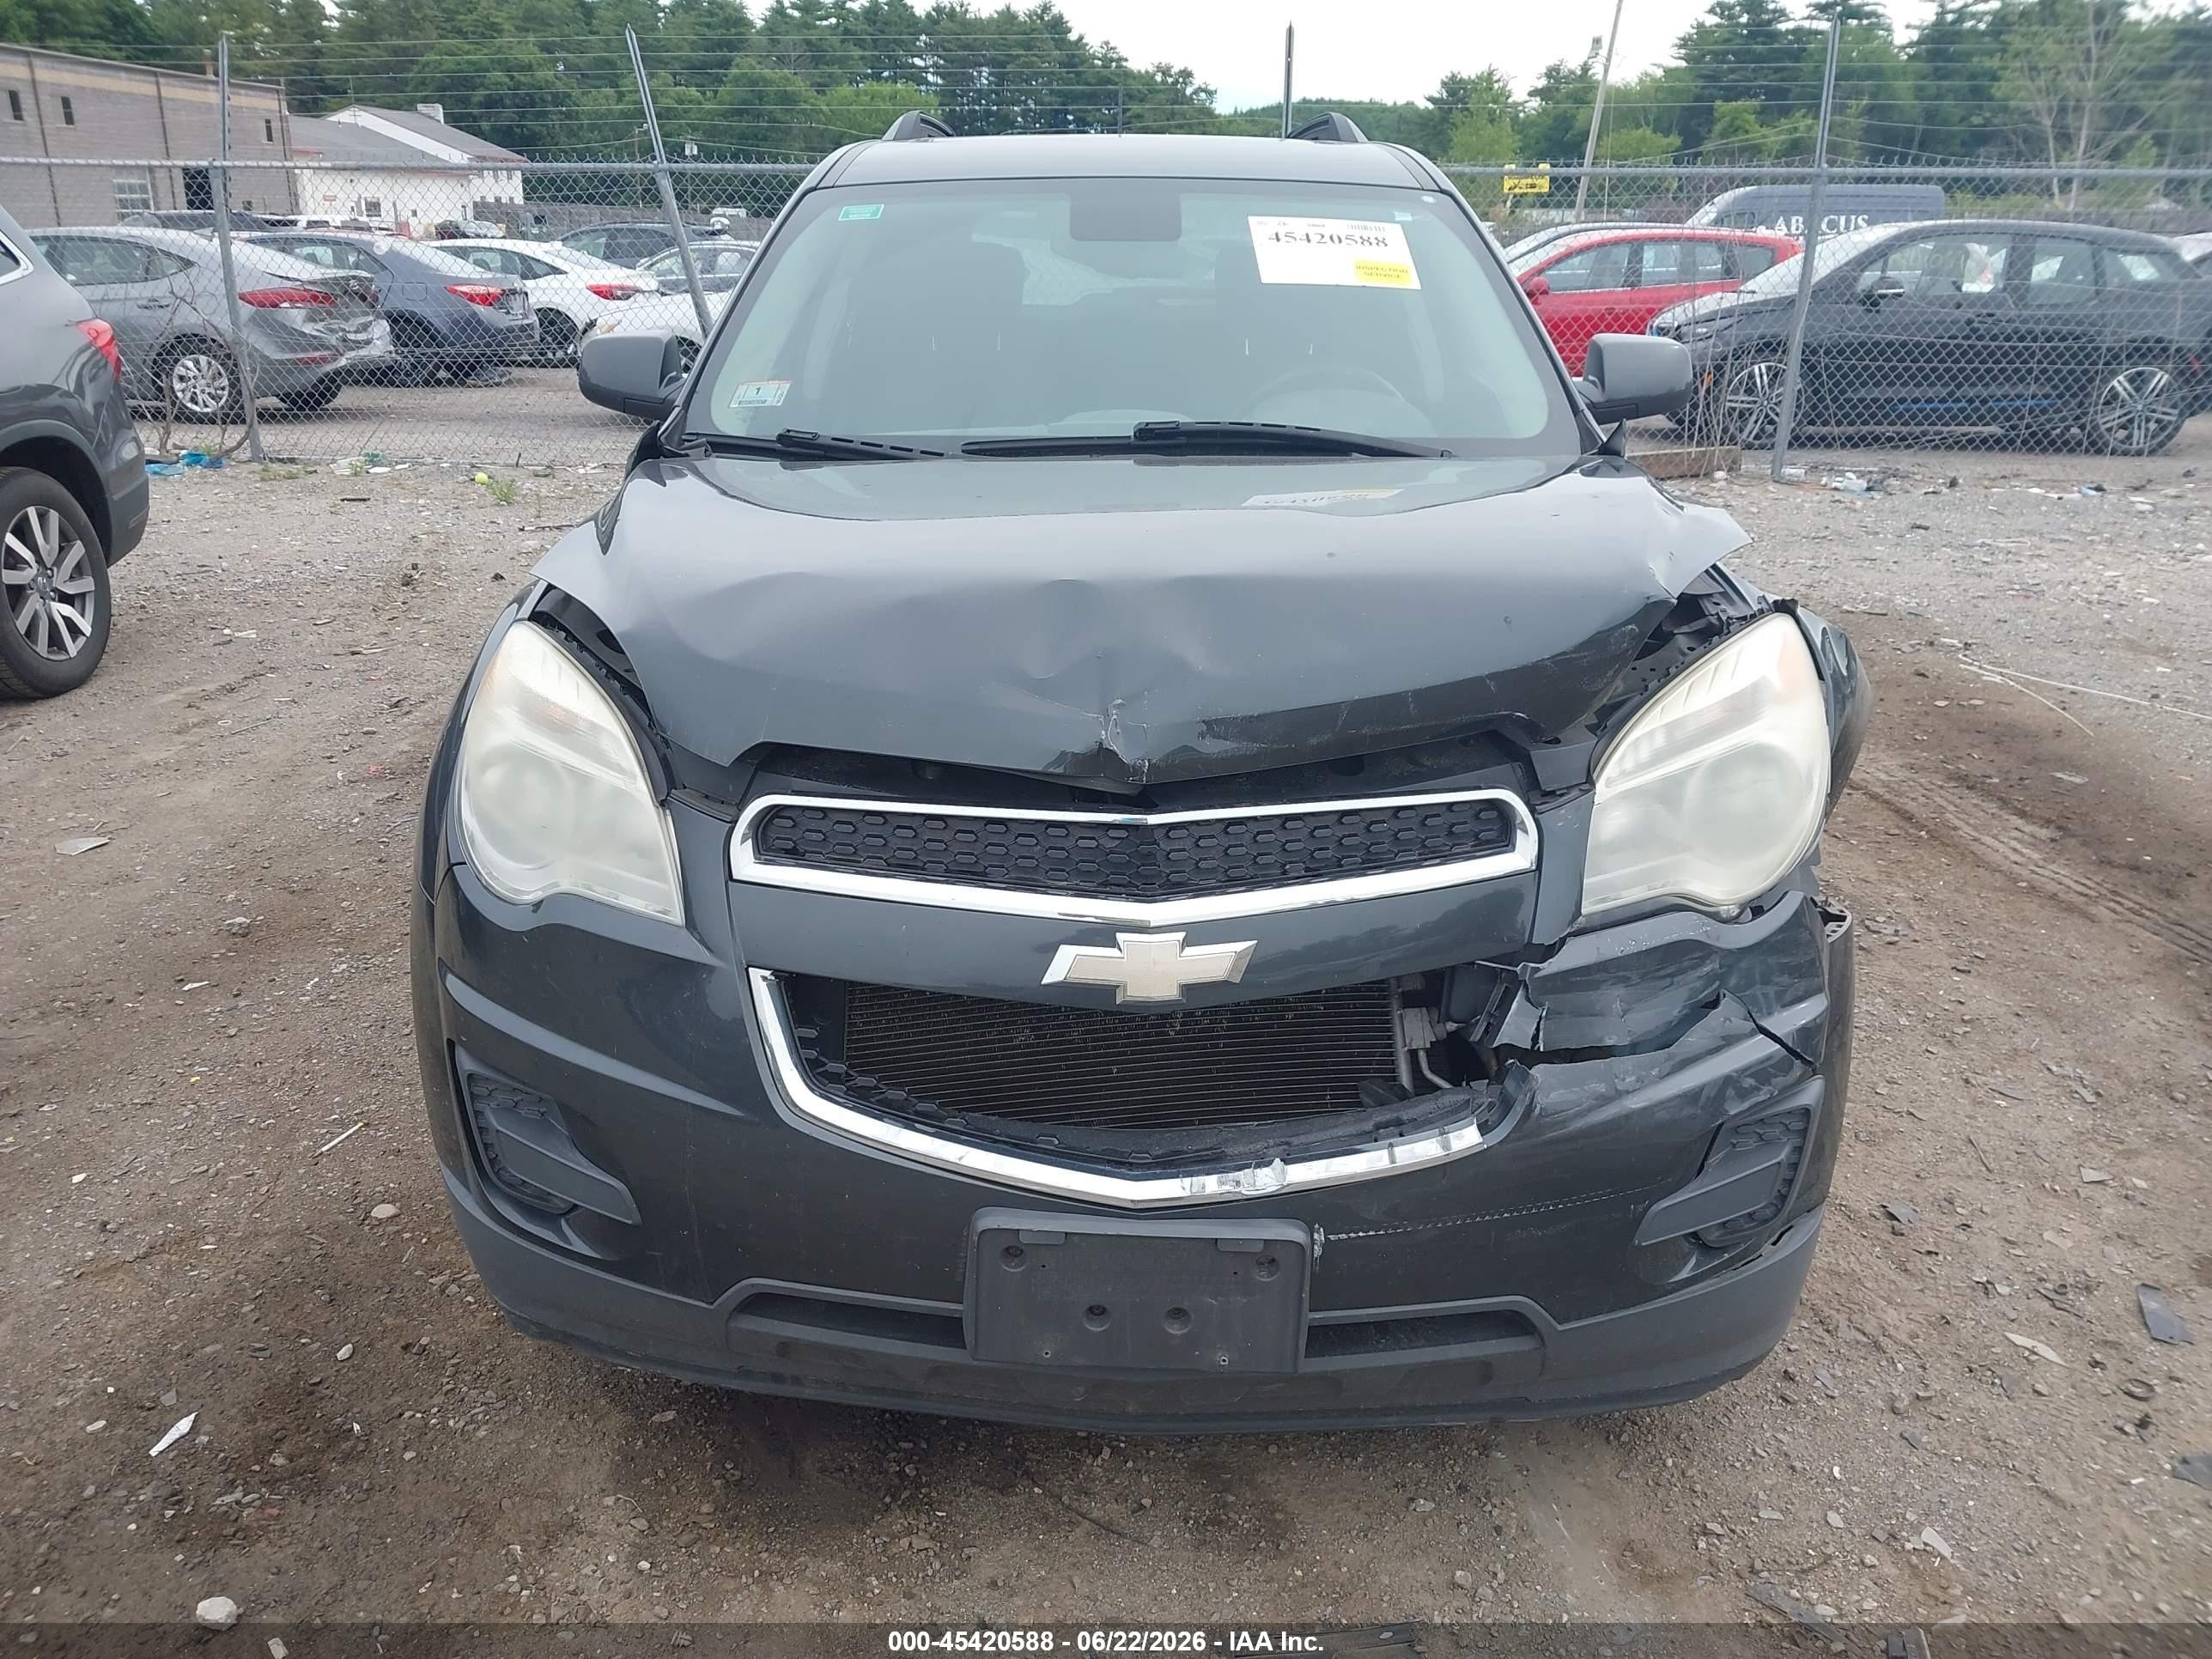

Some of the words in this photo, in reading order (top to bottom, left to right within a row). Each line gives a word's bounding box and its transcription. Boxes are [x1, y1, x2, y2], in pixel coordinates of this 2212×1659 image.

[1774, 215, 1869, 234] ABCUS
[1268, 231, 1389, 247] 45420588
[755, 386, 762, 395] 1
